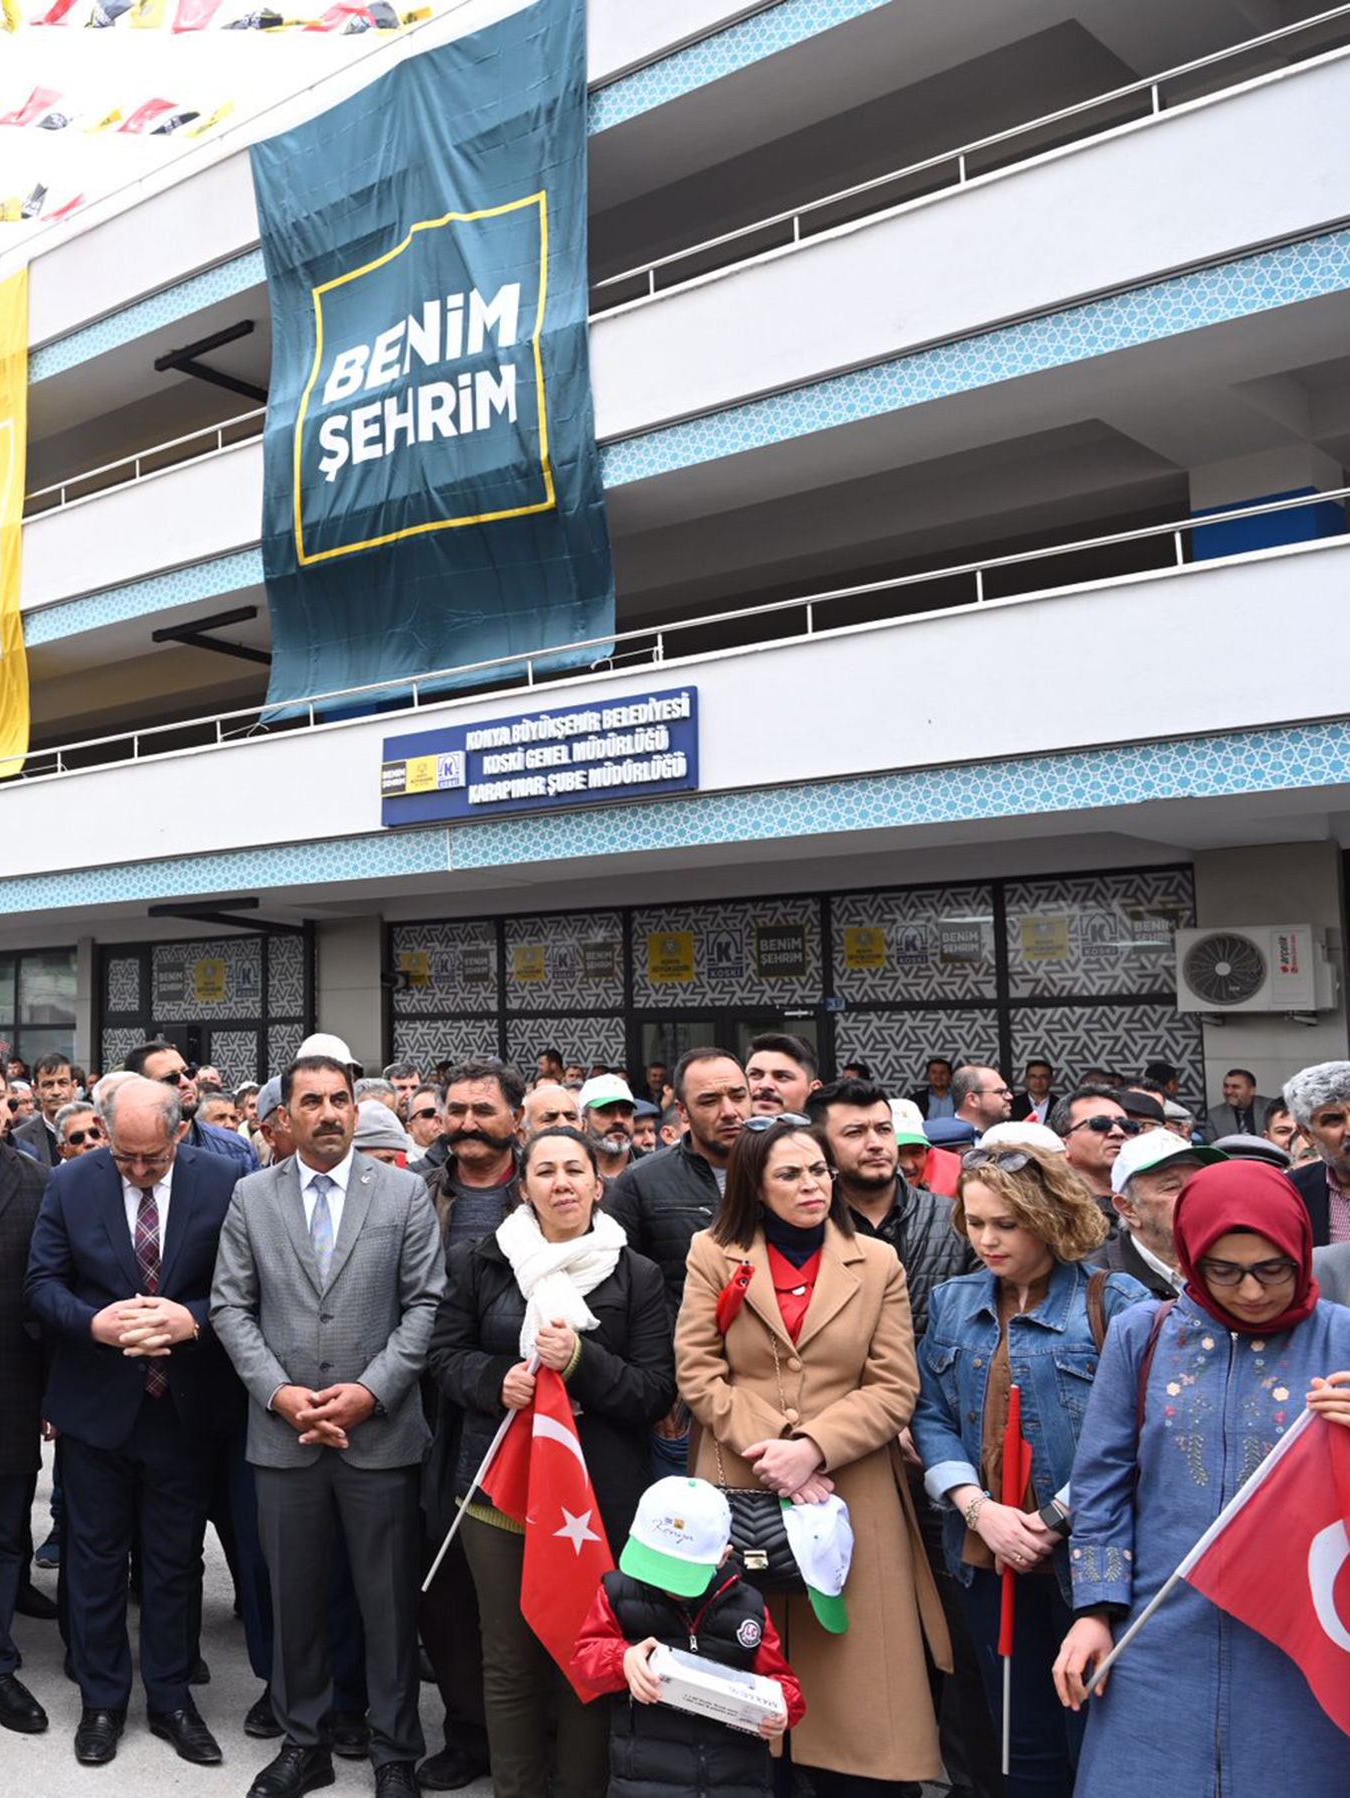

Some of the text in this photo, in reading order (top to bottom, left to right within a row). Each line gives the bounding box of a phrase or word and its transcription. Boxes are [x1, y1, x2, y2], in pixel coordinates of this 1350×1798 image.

[322, 283, 520, 405] BENİM
[318, 364, 518, 482] ŞEHRİM
[466, 692, 691, 750] KONYA BÜYÜKŞEHİR BELEDİYESİ
[483, 725, 670, 776] KOSKİ GENEL MÜDÜRLÜĞÜ
[468, 775, 546, 804] KARAPINAR
[547, 769, 588, 797] ŞUBE
[588, 751, 688, 790] MÜDÜRLÜĞÜ
[759, 937, 801, 950] BENİM
[760, 951, 802, 965] ŞEHRİM
